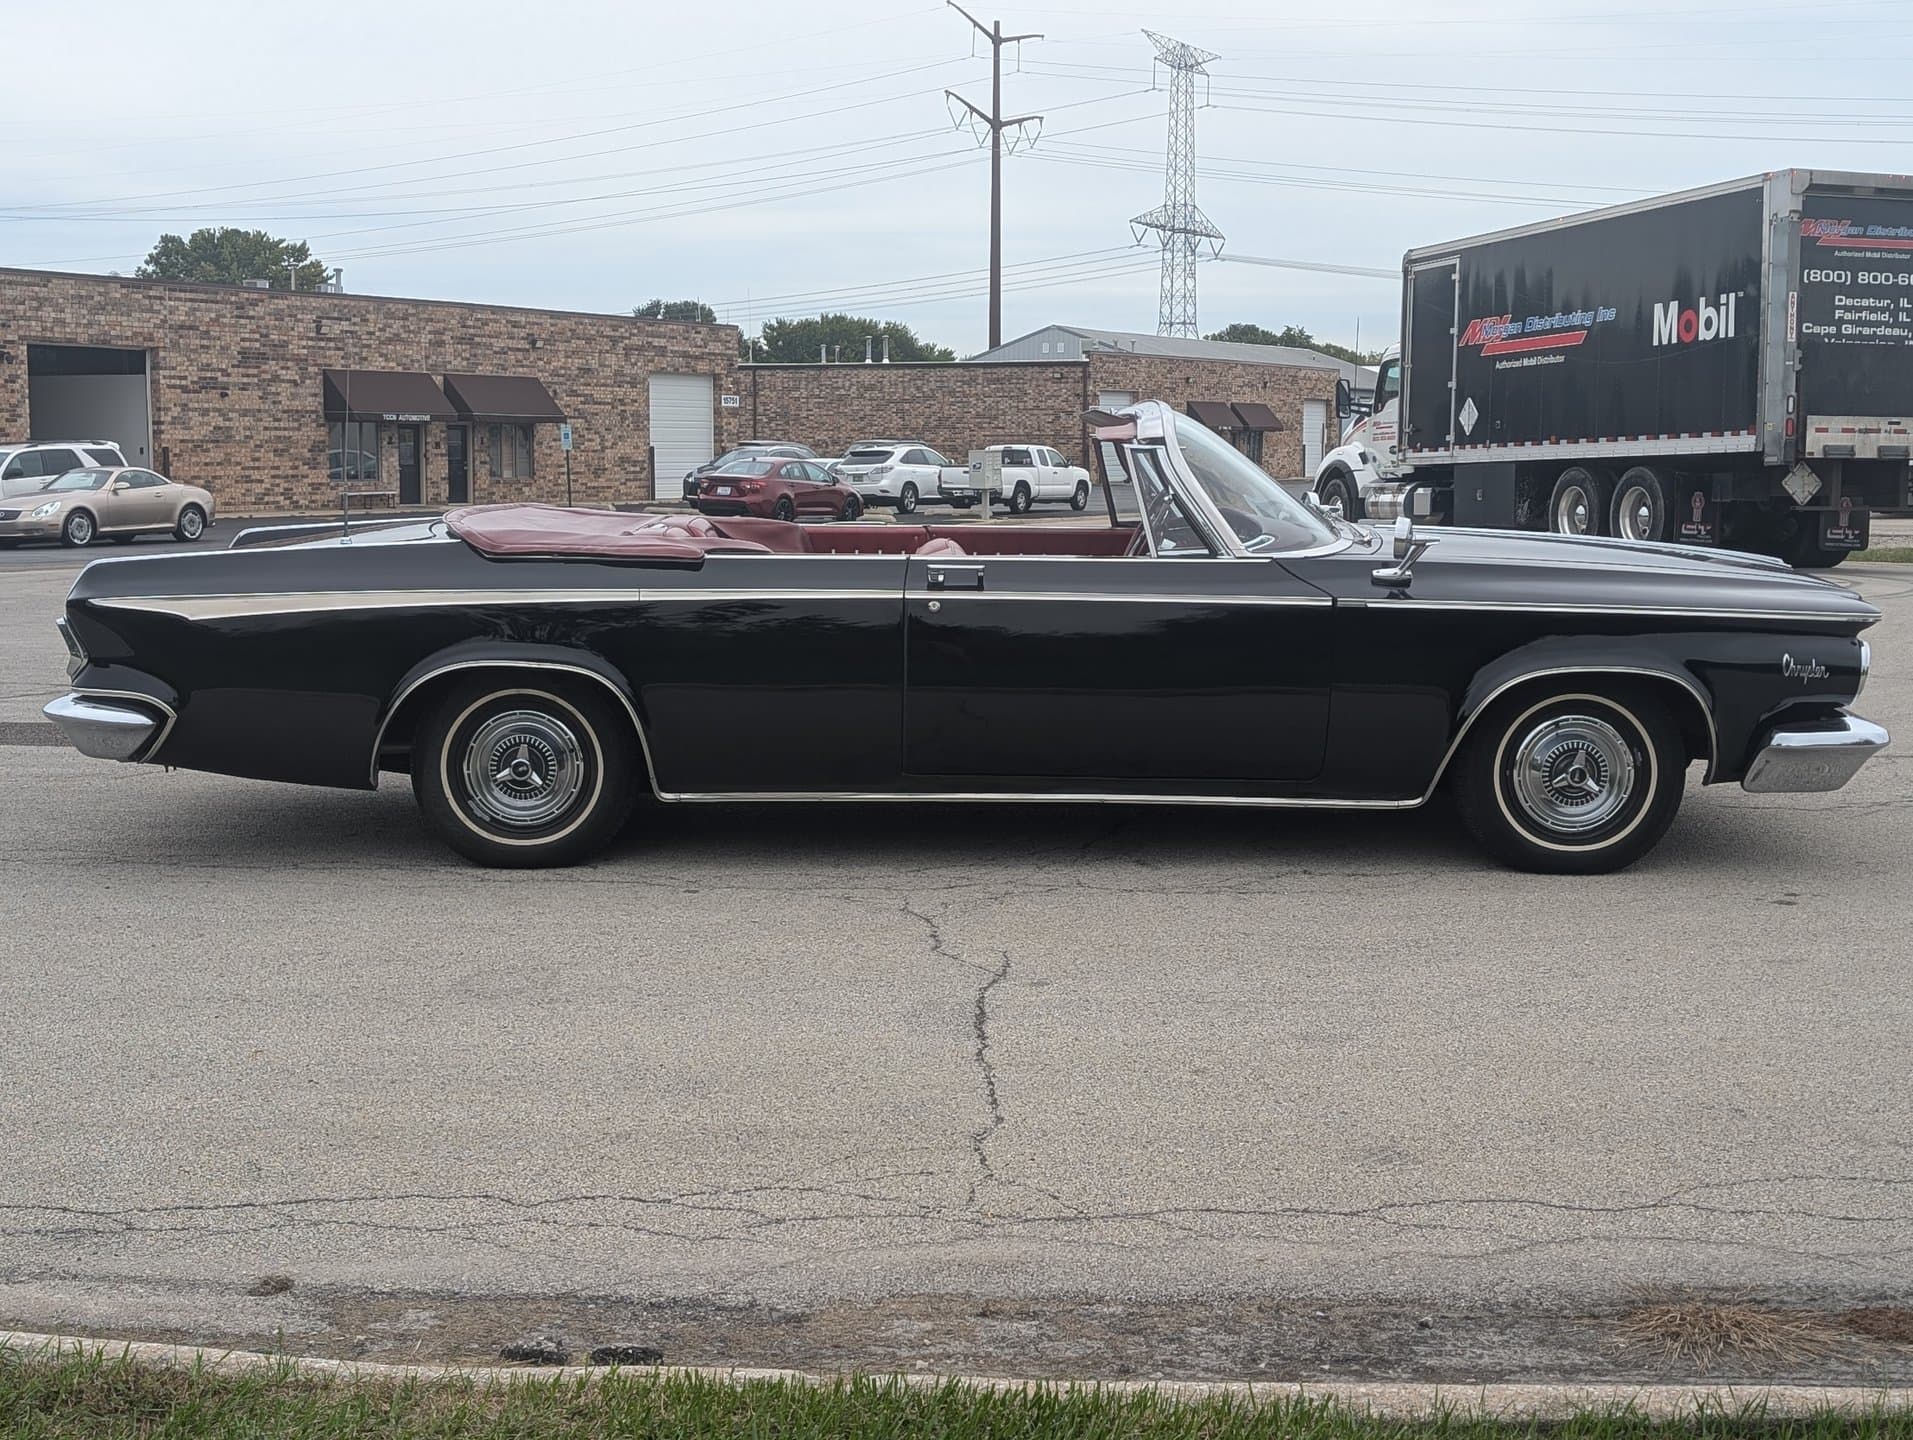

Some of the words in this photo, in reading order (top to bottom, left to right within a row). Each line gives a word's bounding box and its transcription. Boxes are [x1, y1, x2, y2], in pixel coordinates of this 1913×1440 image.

[1803, 269, 1851, 285] (800)
[1835, 295, 1894, 309] Decatur,
[1899, 297, 1912, 308] IL
[1482, 321, 1523, 338] Morgan
[1525, 309, 1595, 333] Distributing
[1652, 292, 1736, 346] Mobil
[1835, 310, 1893, 323] Fairfield,
[1898, 312, 1911, 322] IL
[1802, 323, 1837, 335] Cape
[1841, 324, 1912, 338] Girardeau,
[1782, 653, 1830, 684] Chrysler
